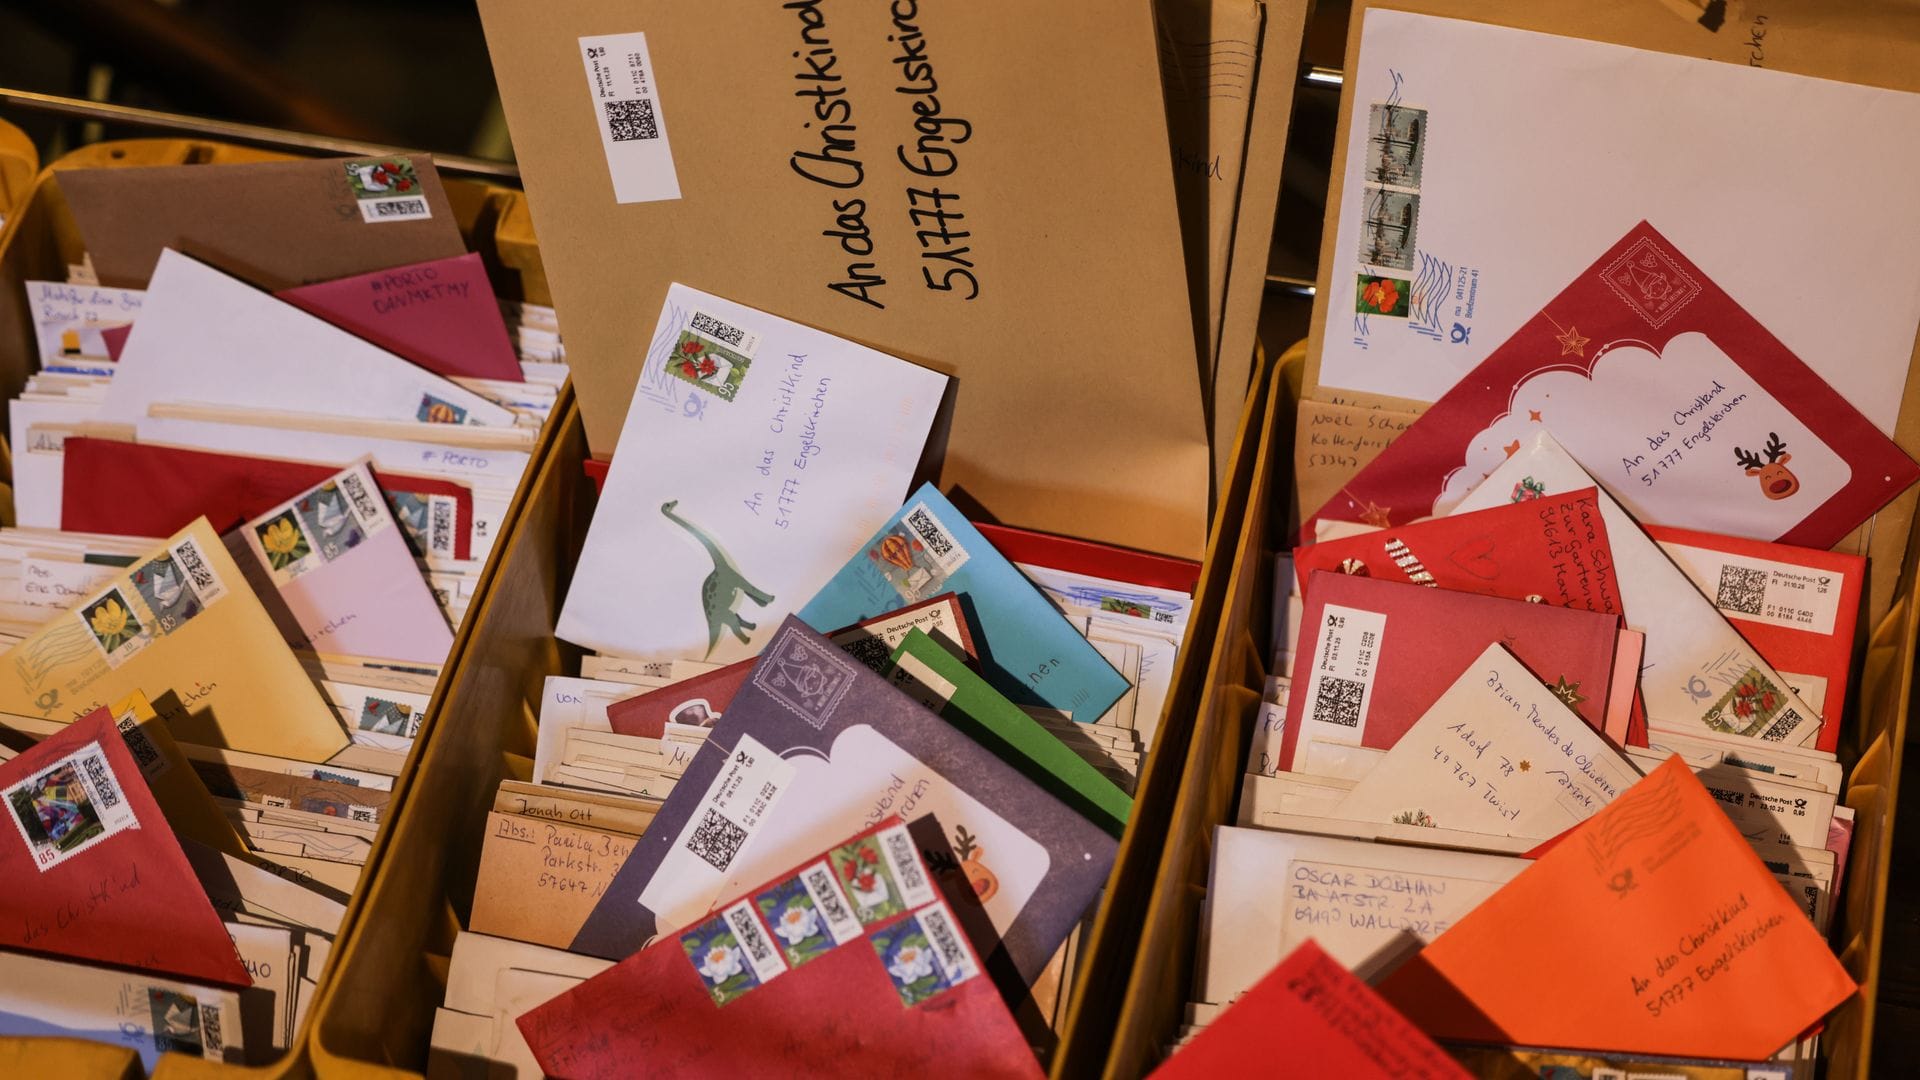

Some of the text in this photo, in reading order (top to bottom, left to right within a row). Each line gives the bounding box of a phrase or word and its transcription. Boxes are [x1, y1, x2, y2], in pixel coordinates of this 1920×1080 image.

[592, 60, 600, 73] Post
[782, 0, 887, 311] An das Christkind
[905, 186, 980, 301] 51777
[1622, 380, 1727, 476] An das Christkind
[1682, 392, 1748, 451] Engelskirchen
[743, 491, 765, 516] An
[776, 478, 802, 530] 51777
[1772, 570, 1816, 584] Deutsche Post
[886, 616, 929, 634] Deutsche Post
[1320, 641, 1331, 670] Deutsche
[1486, 670, 1522, 712] Brian
[1574, 754, 1617, 799] Oliveira
[712, 764, 740, 804] Deutsche Post
[514, 798, 594, 821] Jonah Ott
[1750, 792, 1794, 806] Deutsche Post
[38, 848, 57, 866] 85
[537, 872, 588, 892] 57647
[1294, 866, 1358, 887] OSCAR
